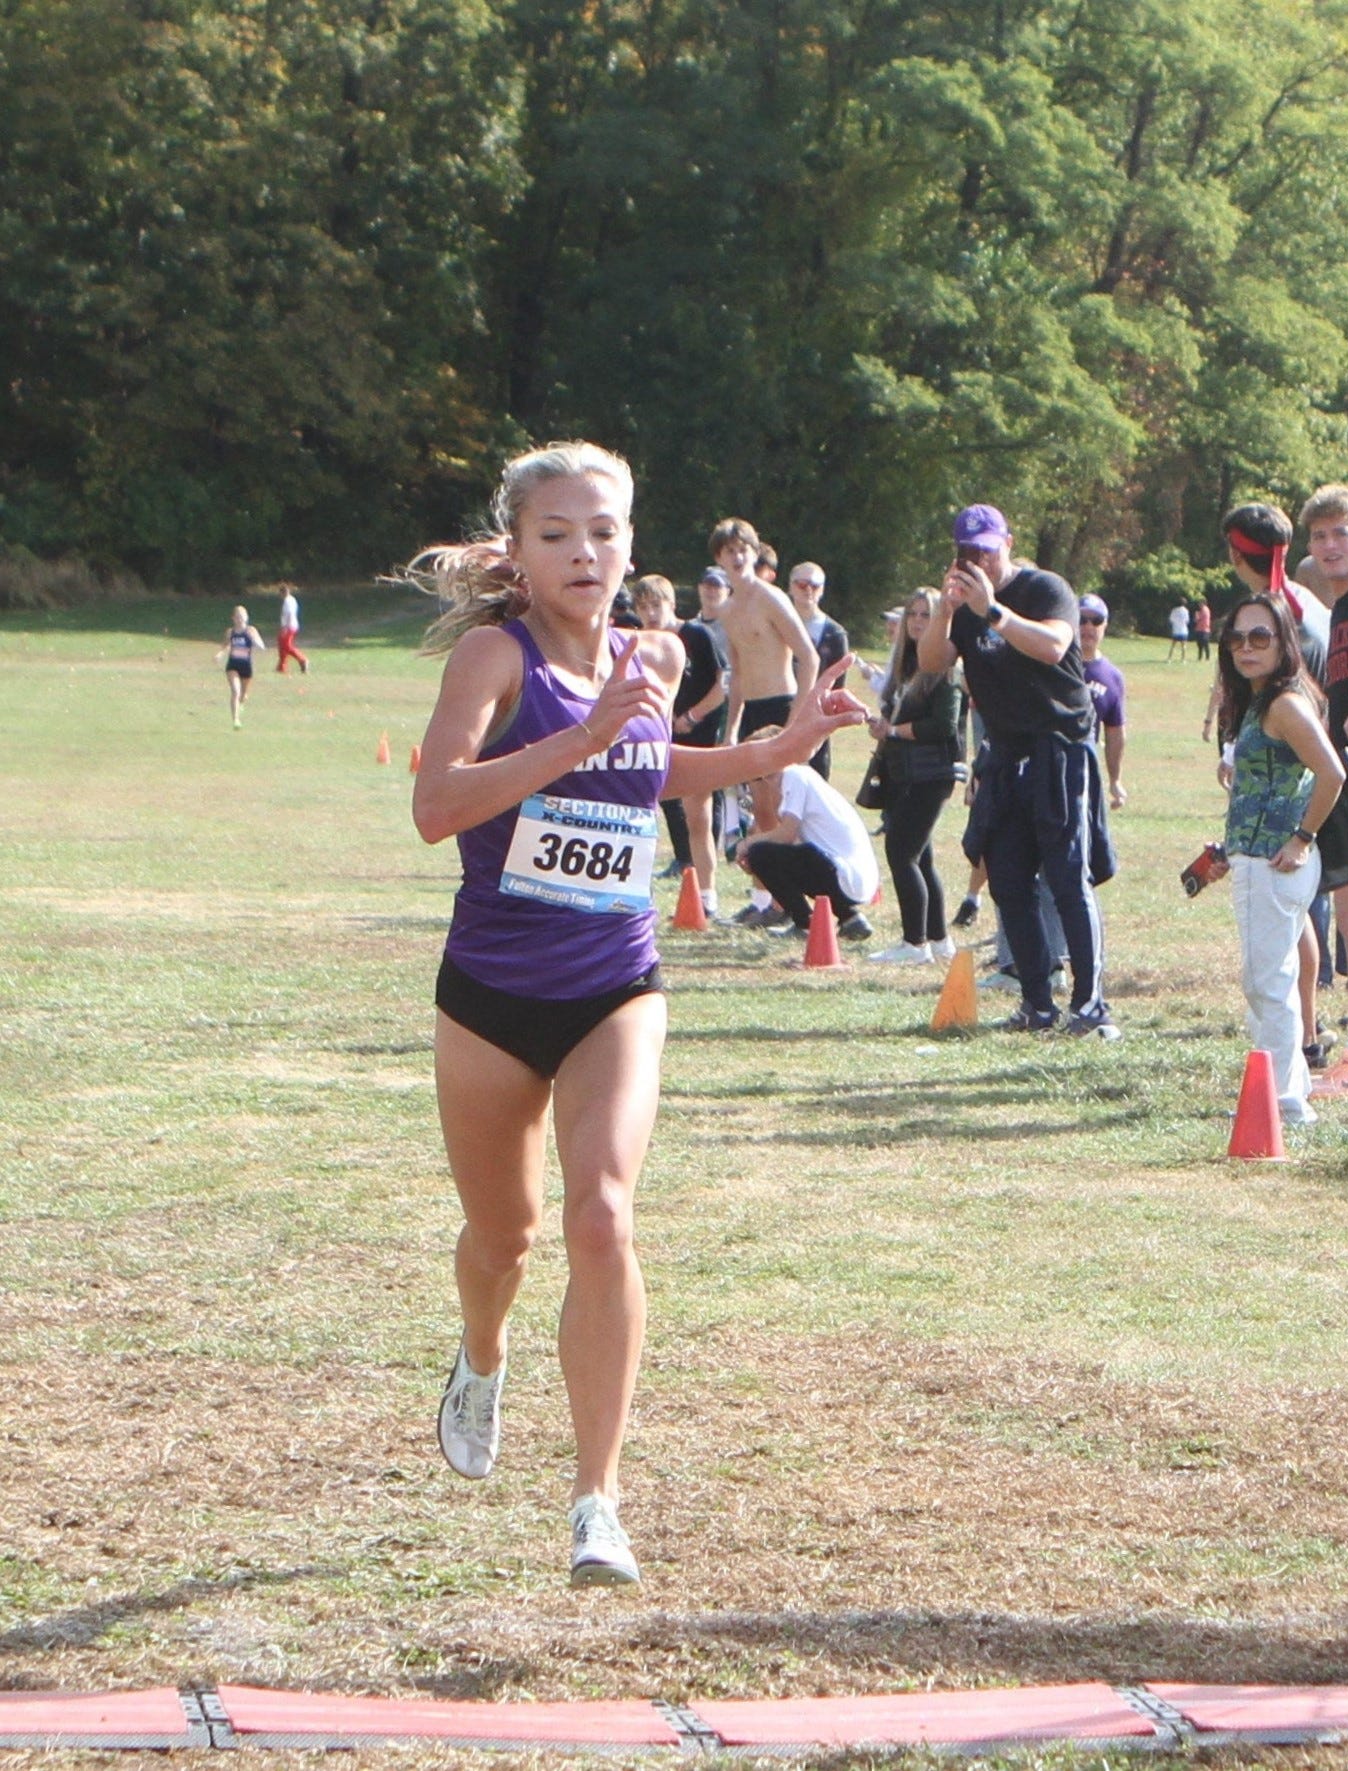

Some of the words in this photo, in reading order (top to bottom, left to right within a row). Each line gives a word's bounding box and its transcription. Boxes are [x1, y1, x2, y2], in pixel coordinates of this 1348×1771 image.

[614, 742, 667, 771] JAY
[543, 795, 632, 822] SECTION
[542, 811, 642, 835] X-COUNTRY
[533, 833, 634, 883] 3684
